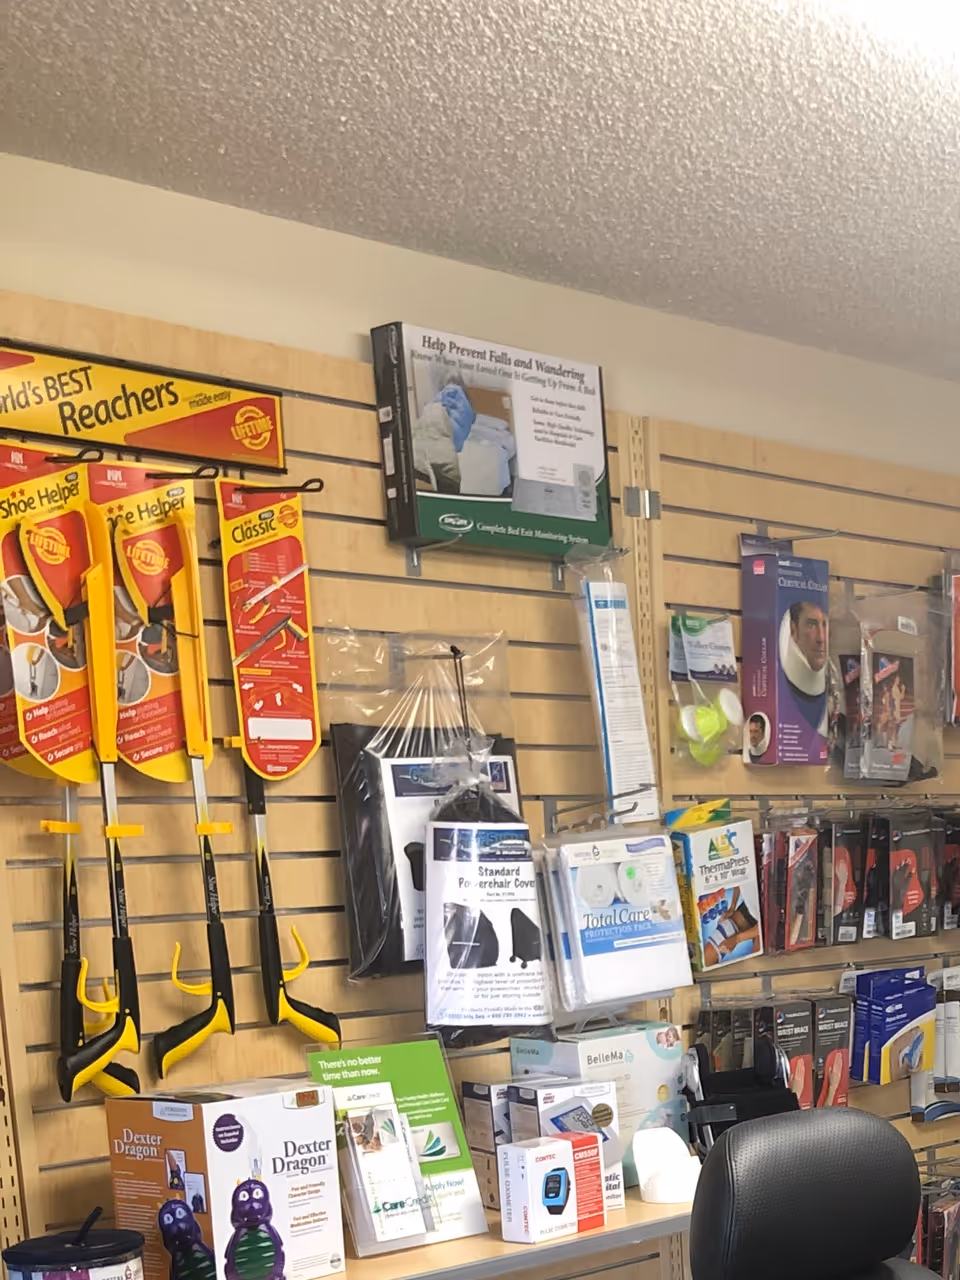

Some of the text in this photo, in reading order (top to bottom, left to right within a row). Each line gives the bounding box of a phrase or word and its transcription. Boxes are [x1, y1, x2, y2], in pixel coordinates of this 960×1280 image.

[422, 335, 585, 384] Help Prevent Falls and Wandering
[43, 365, 93, 402] BEST
[58, 381, 180, 436] Reachers
[0, 479, 81, 520] Shoe Helper
[137, 494, 187, 520] Helper
[232, 517, 277, 546] Classic
[476, 522, 506, 535] Complete
[507, 526, 520, 536] Bed
[521, 528, 534, 537] Exit
[535, 530, 567, 544] Monitoring
[53, 745, 74, 759] Secure
[140, 746, 163, 759] Secure
[478, 866, 521, 877] Standard
[699, 856, 750, 877] ThermaPress
[458, 877, 512, 889] Poerchair
[583, 906, 650, 929] Total Care
[318, 1055, 382, 1070] There's no better
[586, 1050, 624, 1066] BelleMa
[322, 1067, 380, 1081] time than now.
[123, 1128, 163, 1145] Dexter
[114, 1139, 159, 1160] Dragon
[283, 1139, 332, 1158] Dexter
[535, 1153, 557, 1164] CONTEC
[272, 1153, 326, 1175] Dragon
[505, 1179, 513, 1223] OXIMETER
